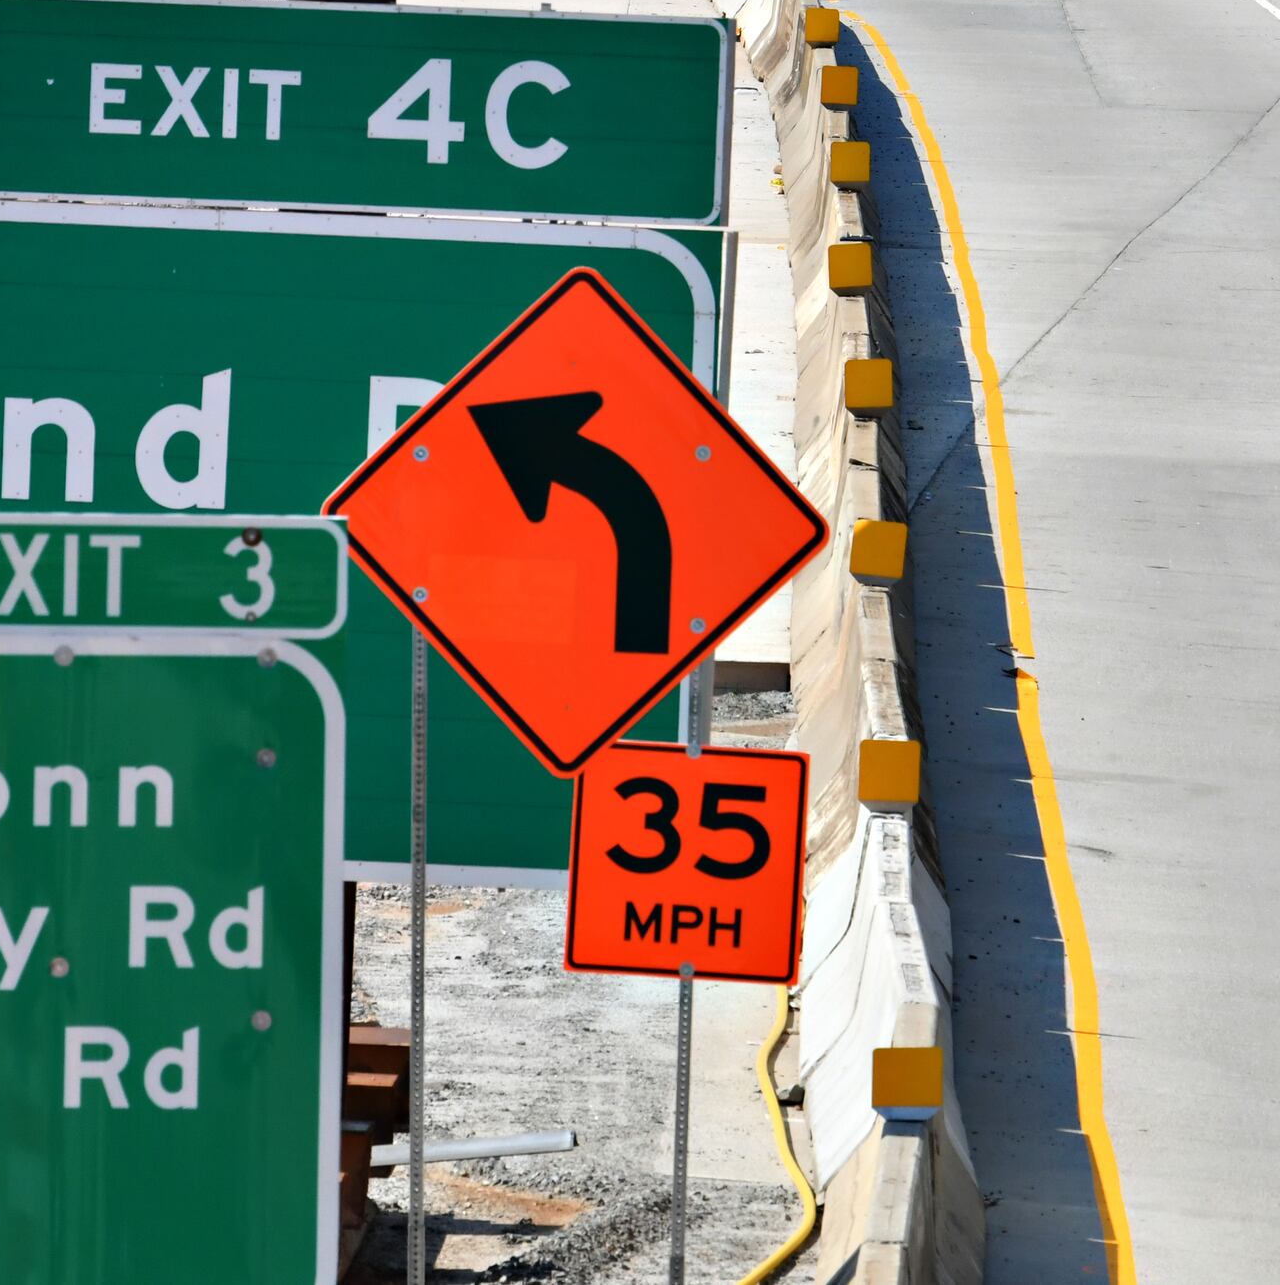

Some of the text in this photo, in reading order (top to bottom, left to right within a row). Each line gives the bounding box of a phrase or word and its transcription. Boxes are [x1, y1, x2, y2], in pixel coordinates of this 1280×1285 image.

[88, 58, 571, 170] EXIT 4C
[220, 534, 276, 621] 3
[606, 776, 771, 880] 35
[128, 885, 264, 969] Rd
[624, 901, 742, 948] MPH
[63, 1025, 200, 1110] Rd
